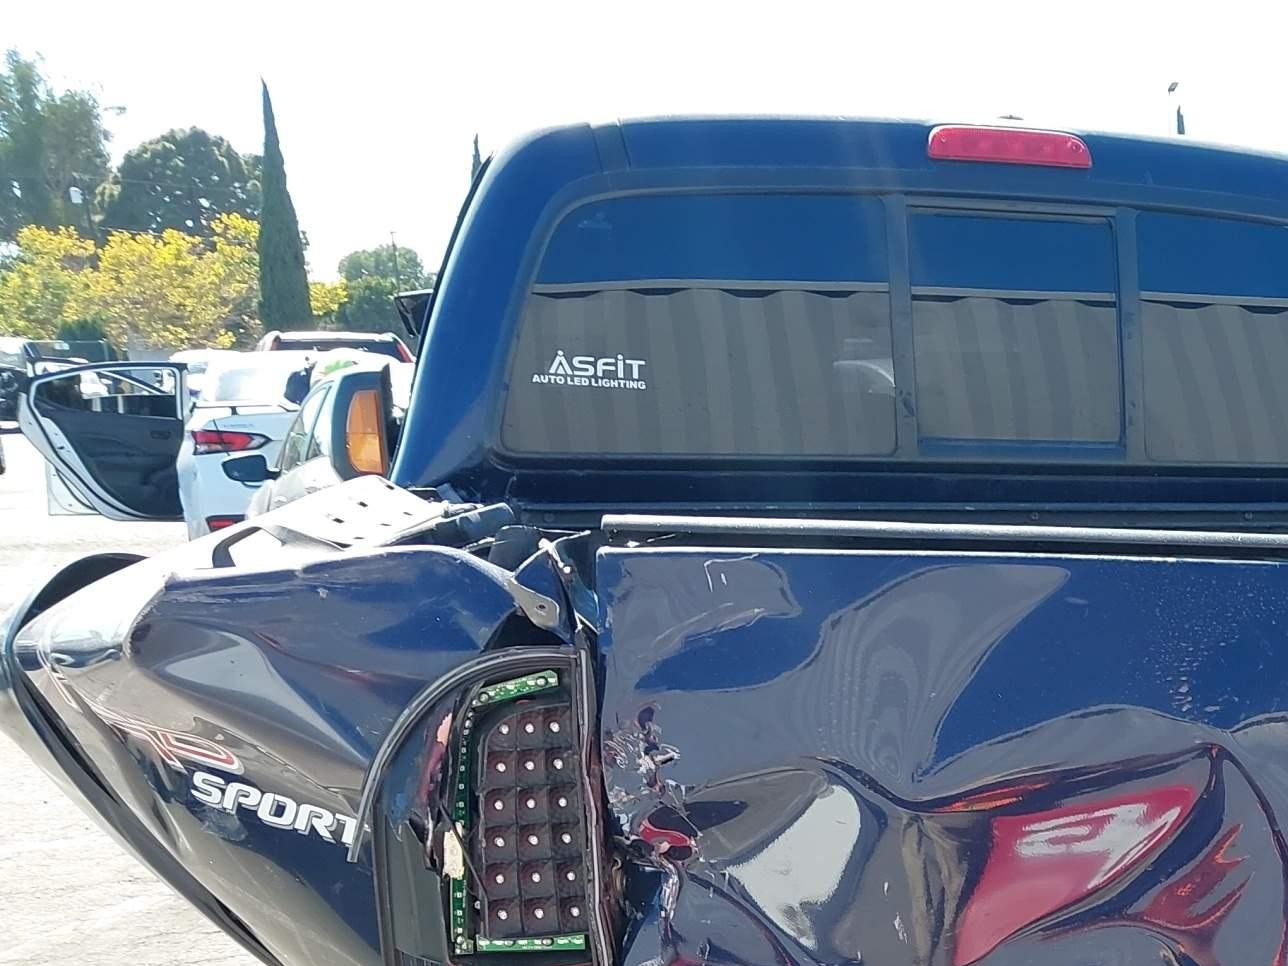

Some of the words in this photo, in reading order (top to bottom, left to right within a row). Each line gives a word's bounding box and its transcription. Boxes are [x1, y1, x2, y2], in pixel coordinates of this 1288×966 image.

[532, 374, 565, 385] AUTO
[567, 376, 590, 386] LED
[591, 378, 647, 389] LIGHTING
[190, 770, 371, 848] SPORT
